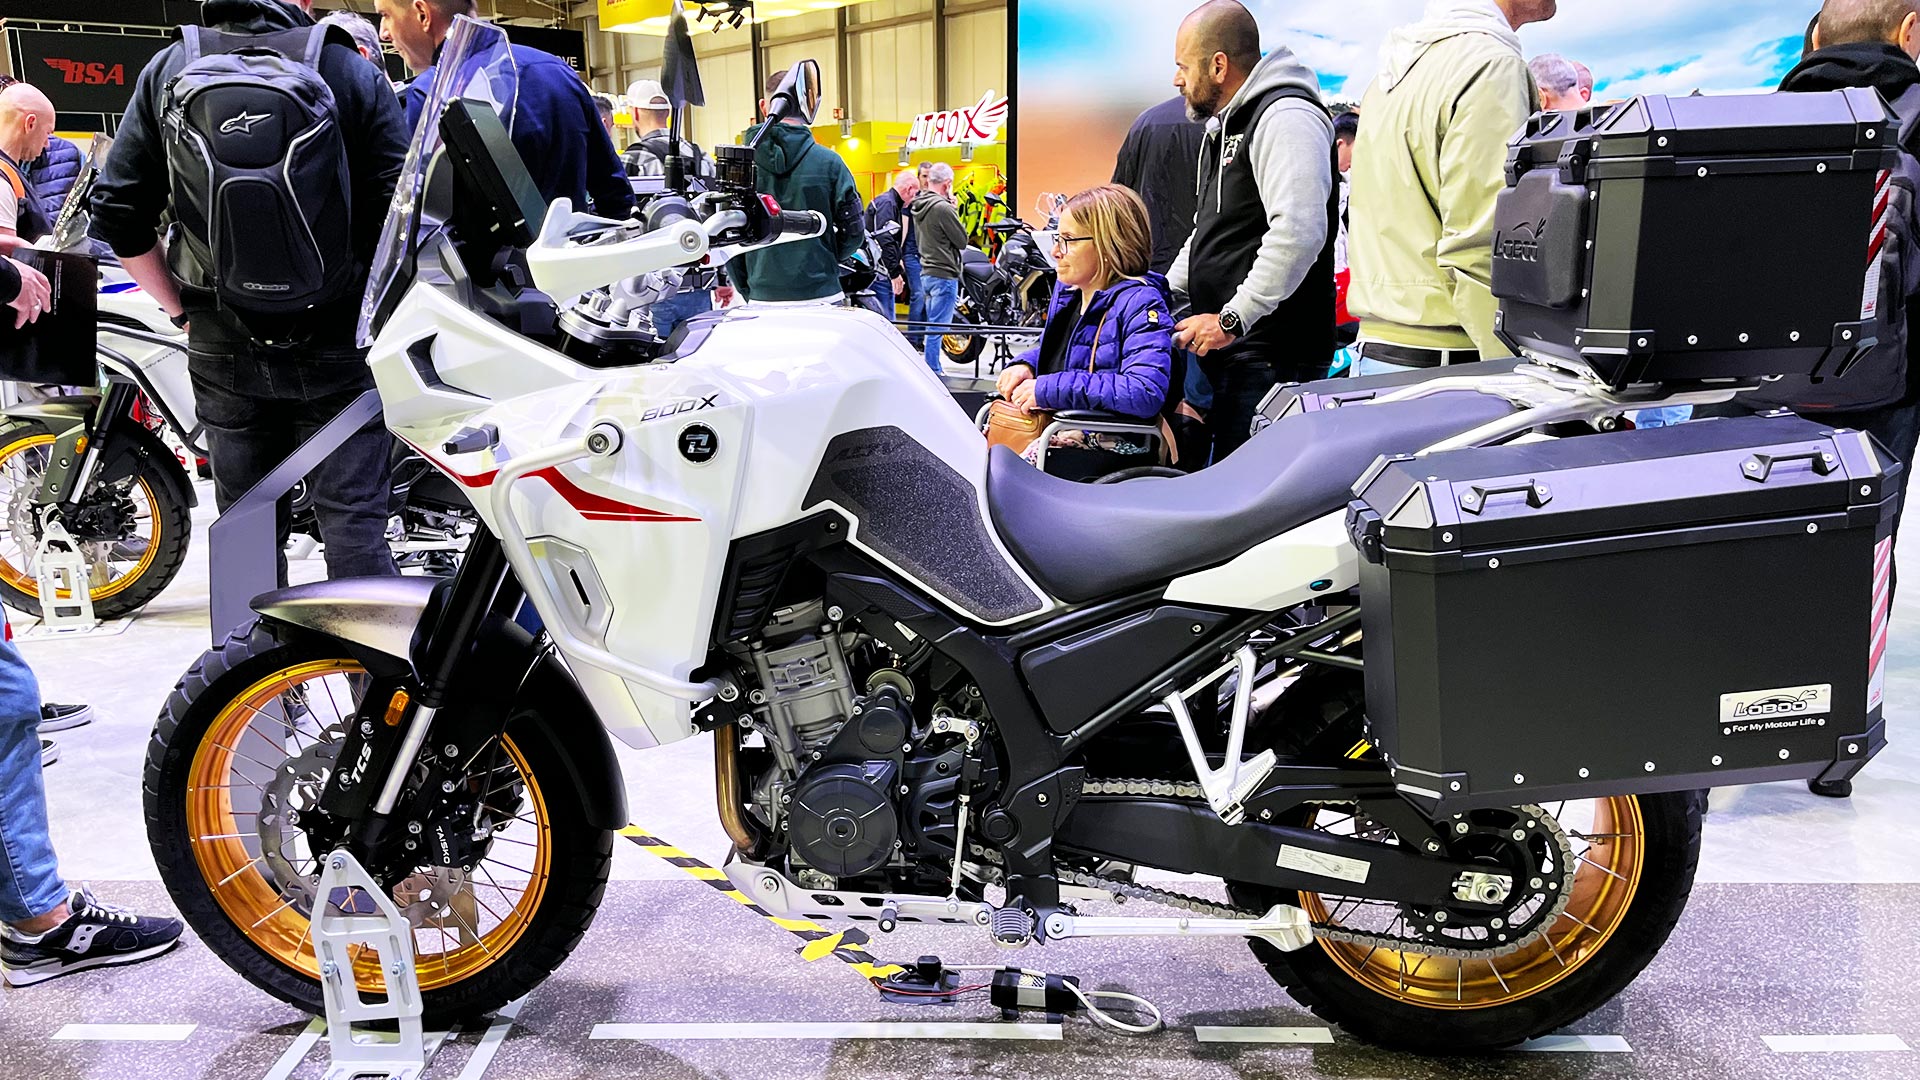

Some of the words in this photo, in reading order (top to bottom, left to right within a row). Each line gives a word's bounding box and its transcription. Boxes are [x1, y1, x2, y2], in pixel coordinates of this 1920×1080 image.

[56, 60, 124, 85] BSA
[640, 393, 719, 422] 800X
[1733, 698, 1808, 717] LOBOO
[1732, 725, 1748, 733] For
[1749, 723, 1764, 731] My
[1765, 719, 1798, 729] Motour
[1800, 718, 1816, 726] Life
[351, 742, 372, 784] TCS
[436, 825, 450, 864] TAISKO
